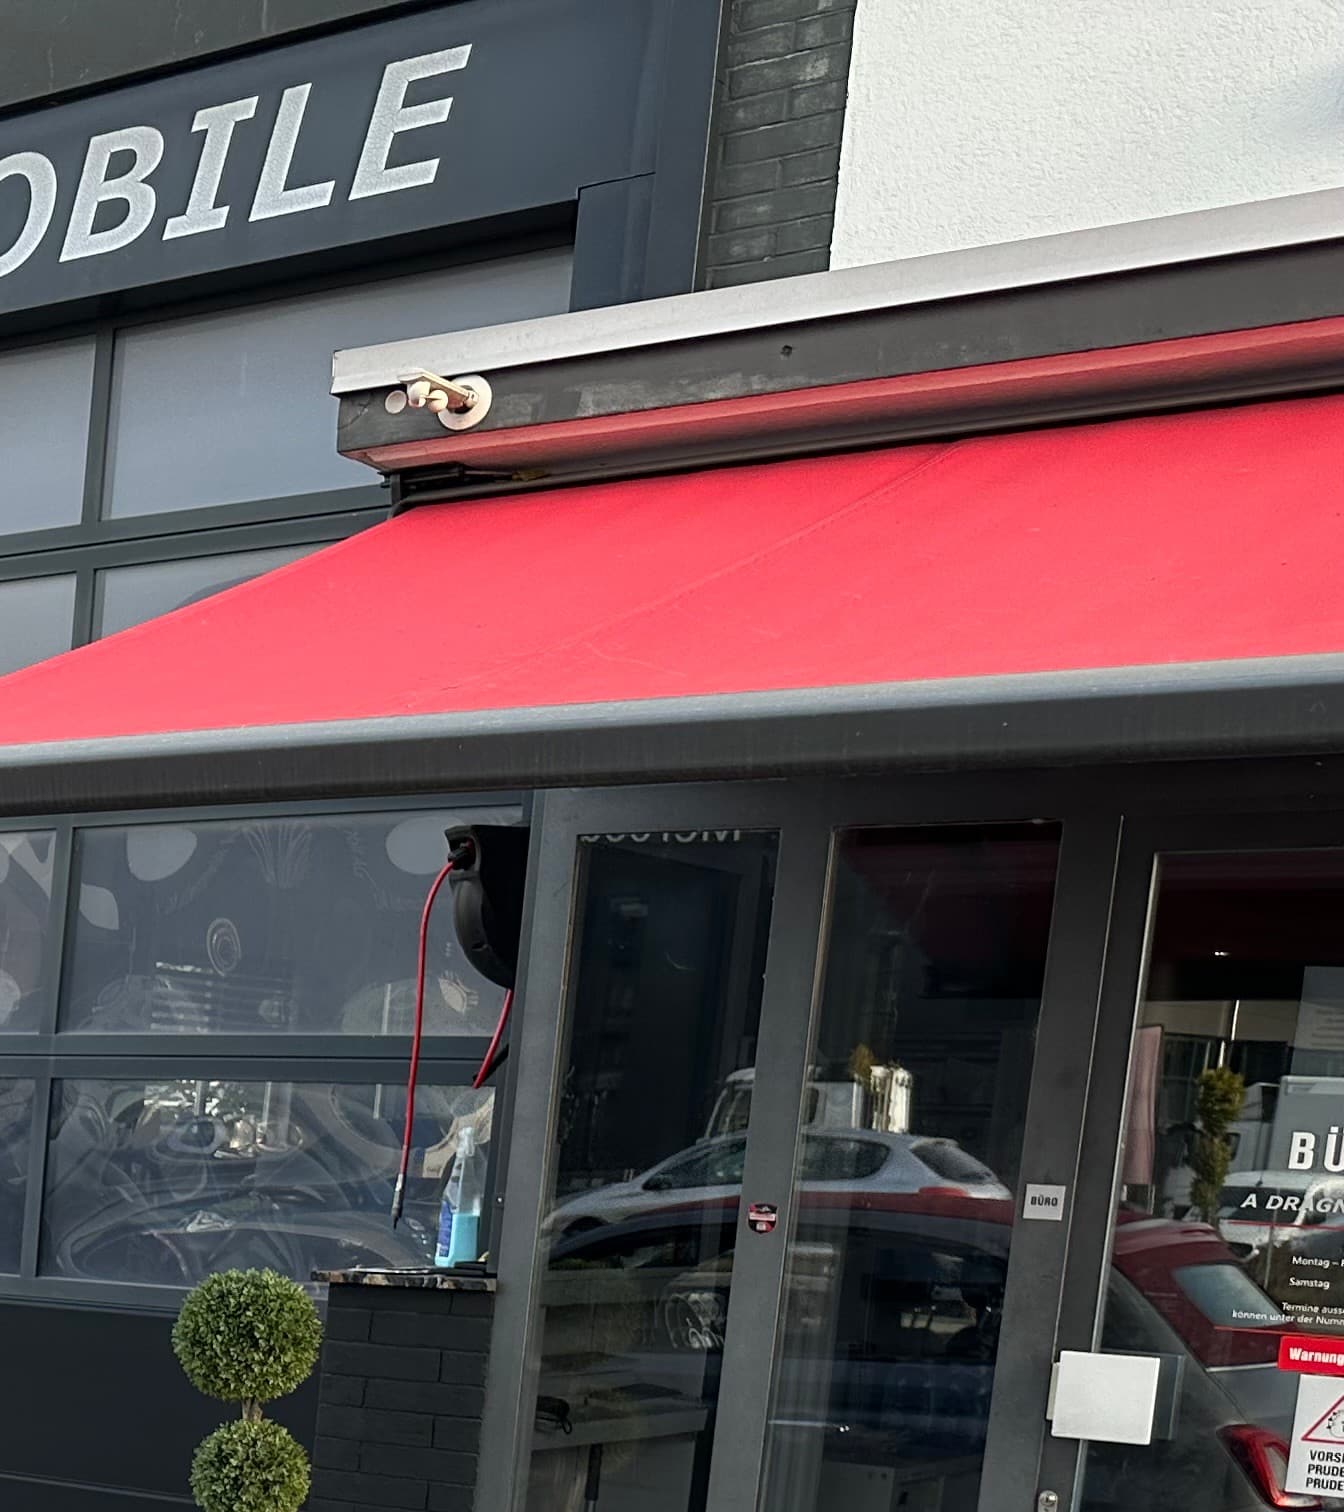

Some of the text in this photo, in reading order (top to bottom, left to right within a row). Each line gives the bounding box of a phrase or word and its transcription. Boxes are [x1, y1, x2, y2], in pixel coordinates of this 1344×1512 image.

[1292, 1256, 1330, 1268] Montag
[1289, 1277, 1330, 1290] Samstag
[1282, 1302, 1319, 1313] Termine
[1269, 1313, 1295, 1322] unter
[1297, 1314, 1313, 1323] der
[1289, 1347, 1344, 1366] Warnung
